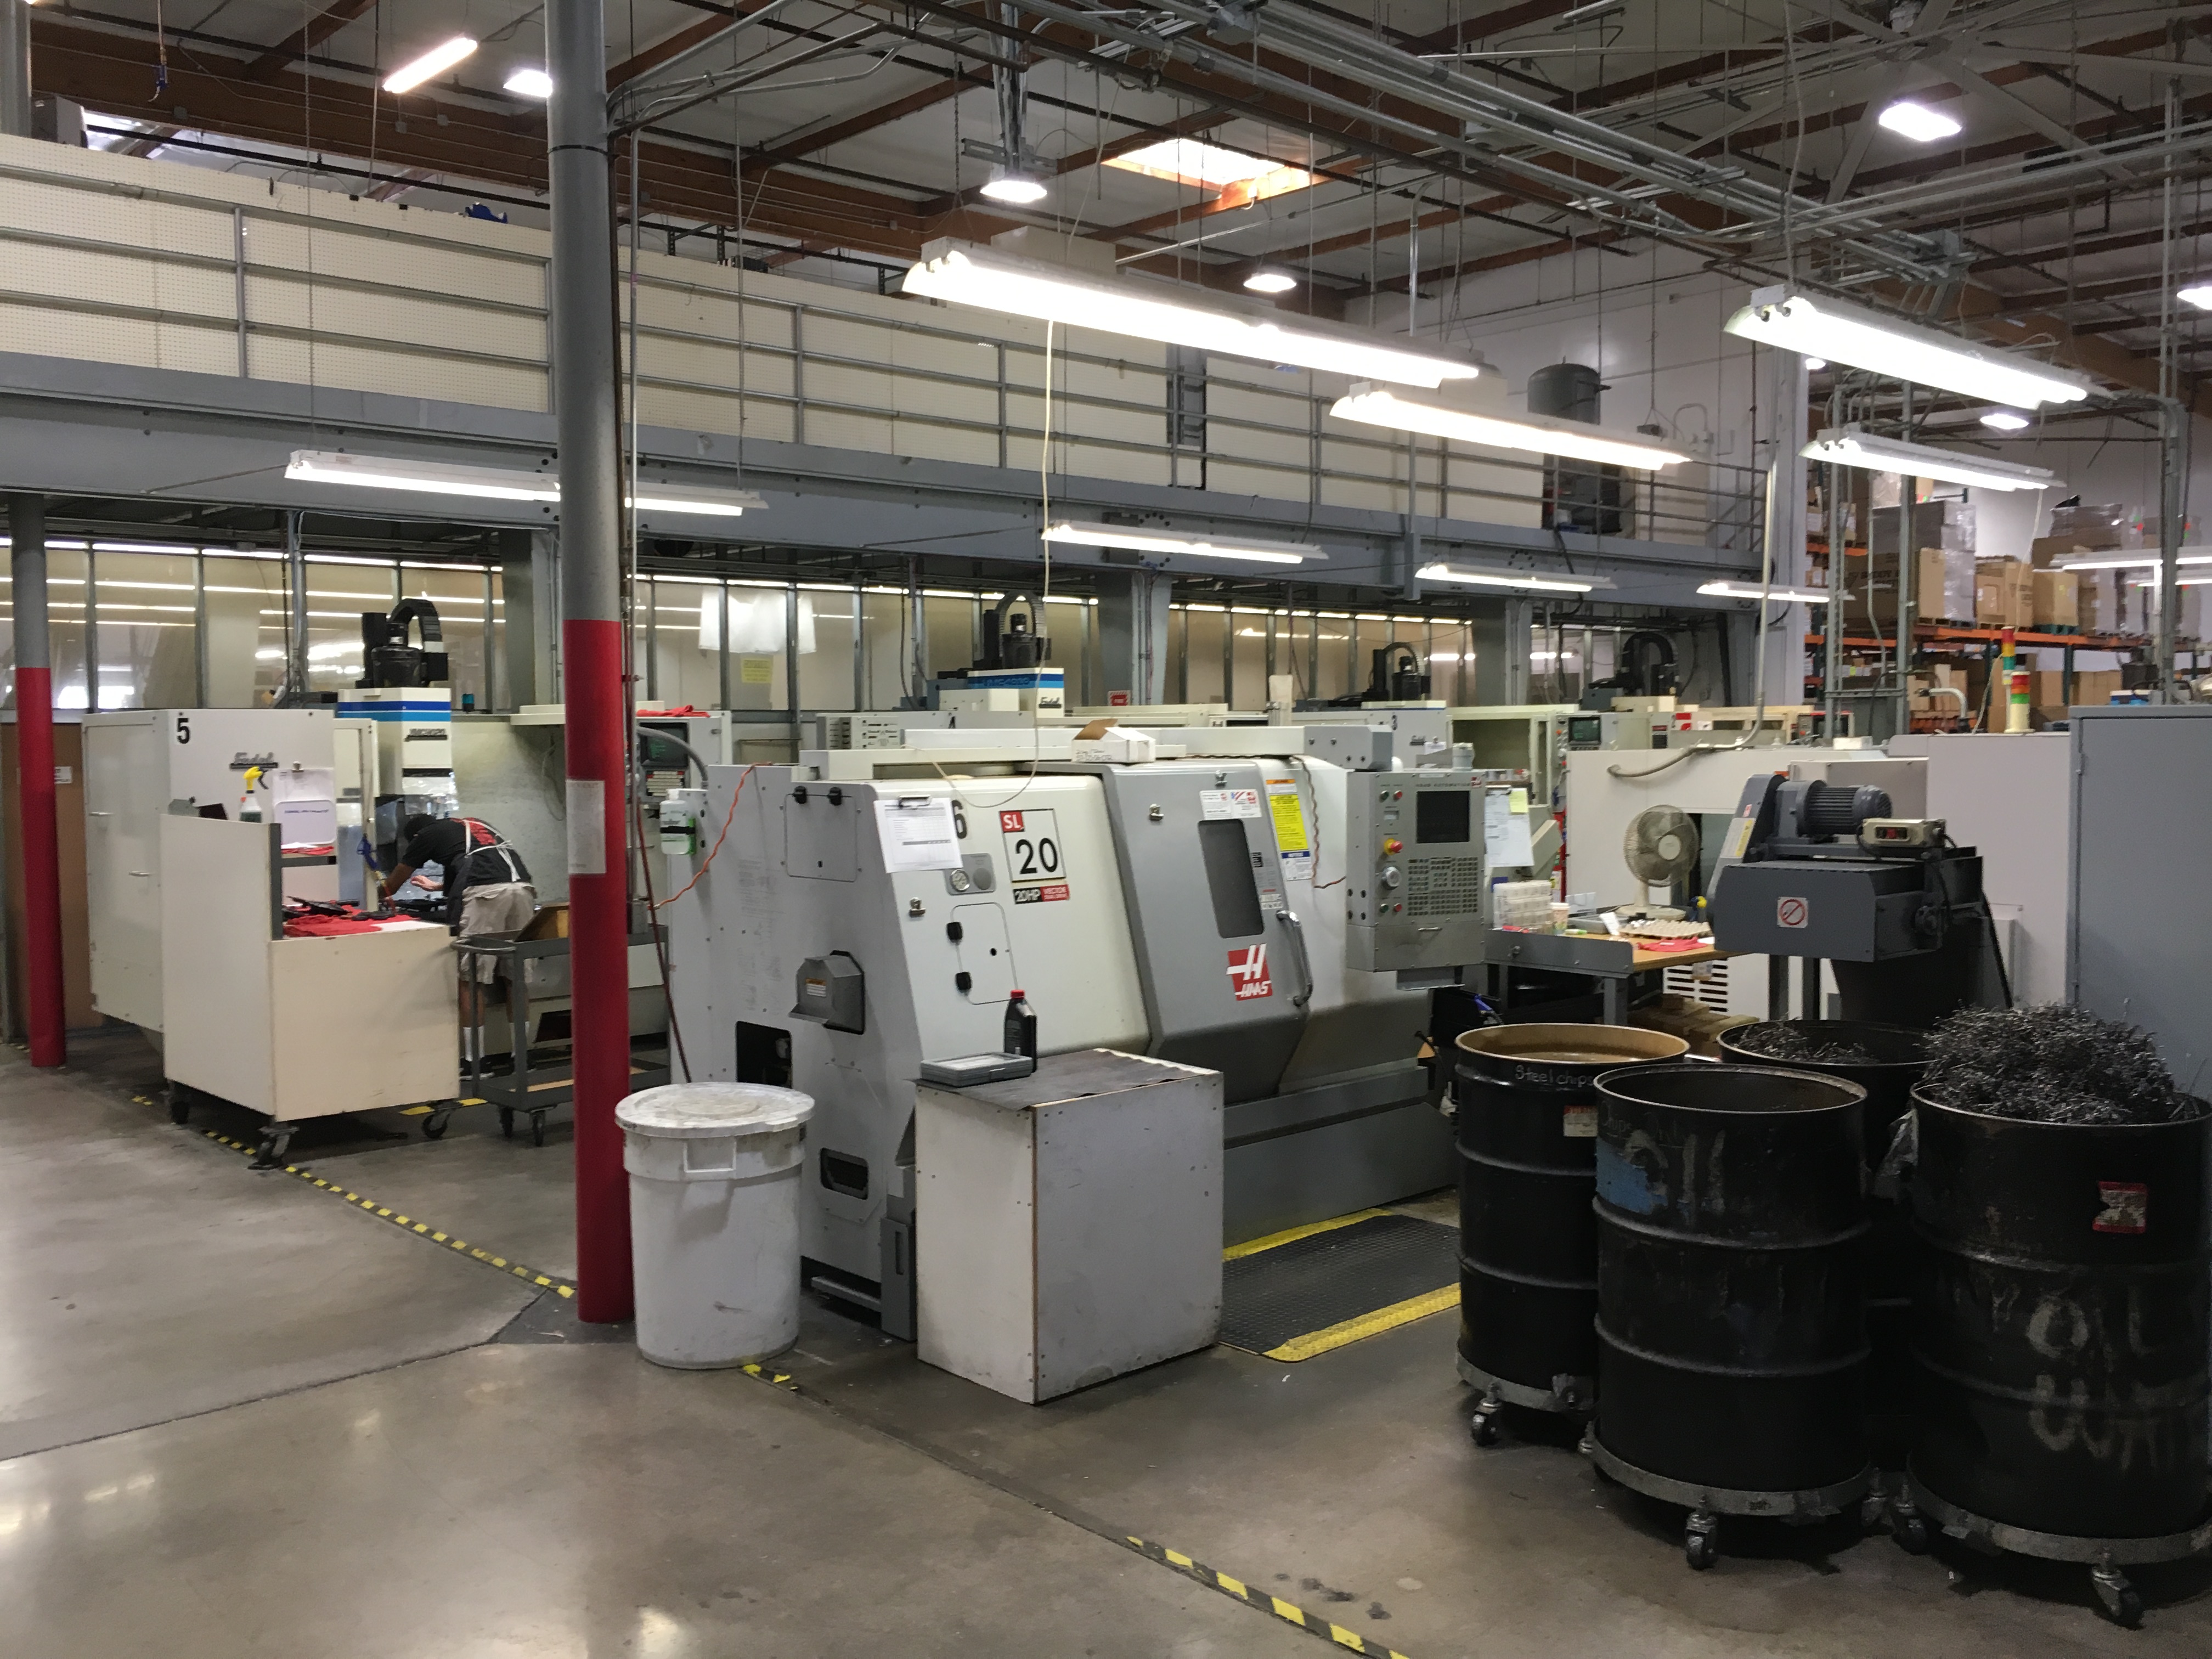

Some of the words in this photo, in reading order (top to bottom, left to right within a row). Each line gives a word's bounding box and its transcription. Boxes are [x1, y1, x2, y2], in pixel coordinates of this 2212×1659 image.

[177, 718, 190, 744] 5
[233, 752, 275, 764] Fadal
[951, 799, 967, 839] 6
[1003, 814, 1022, 829] SL
[1015, 837, 1058, 874] 20
[1014, 888, 1042, 902] 20HP
[1234, 980, 1272, 998] HAAS
[1515, 1064, 1554, 1084] Steel
[1555, 1069, 1594, 1088] chips
